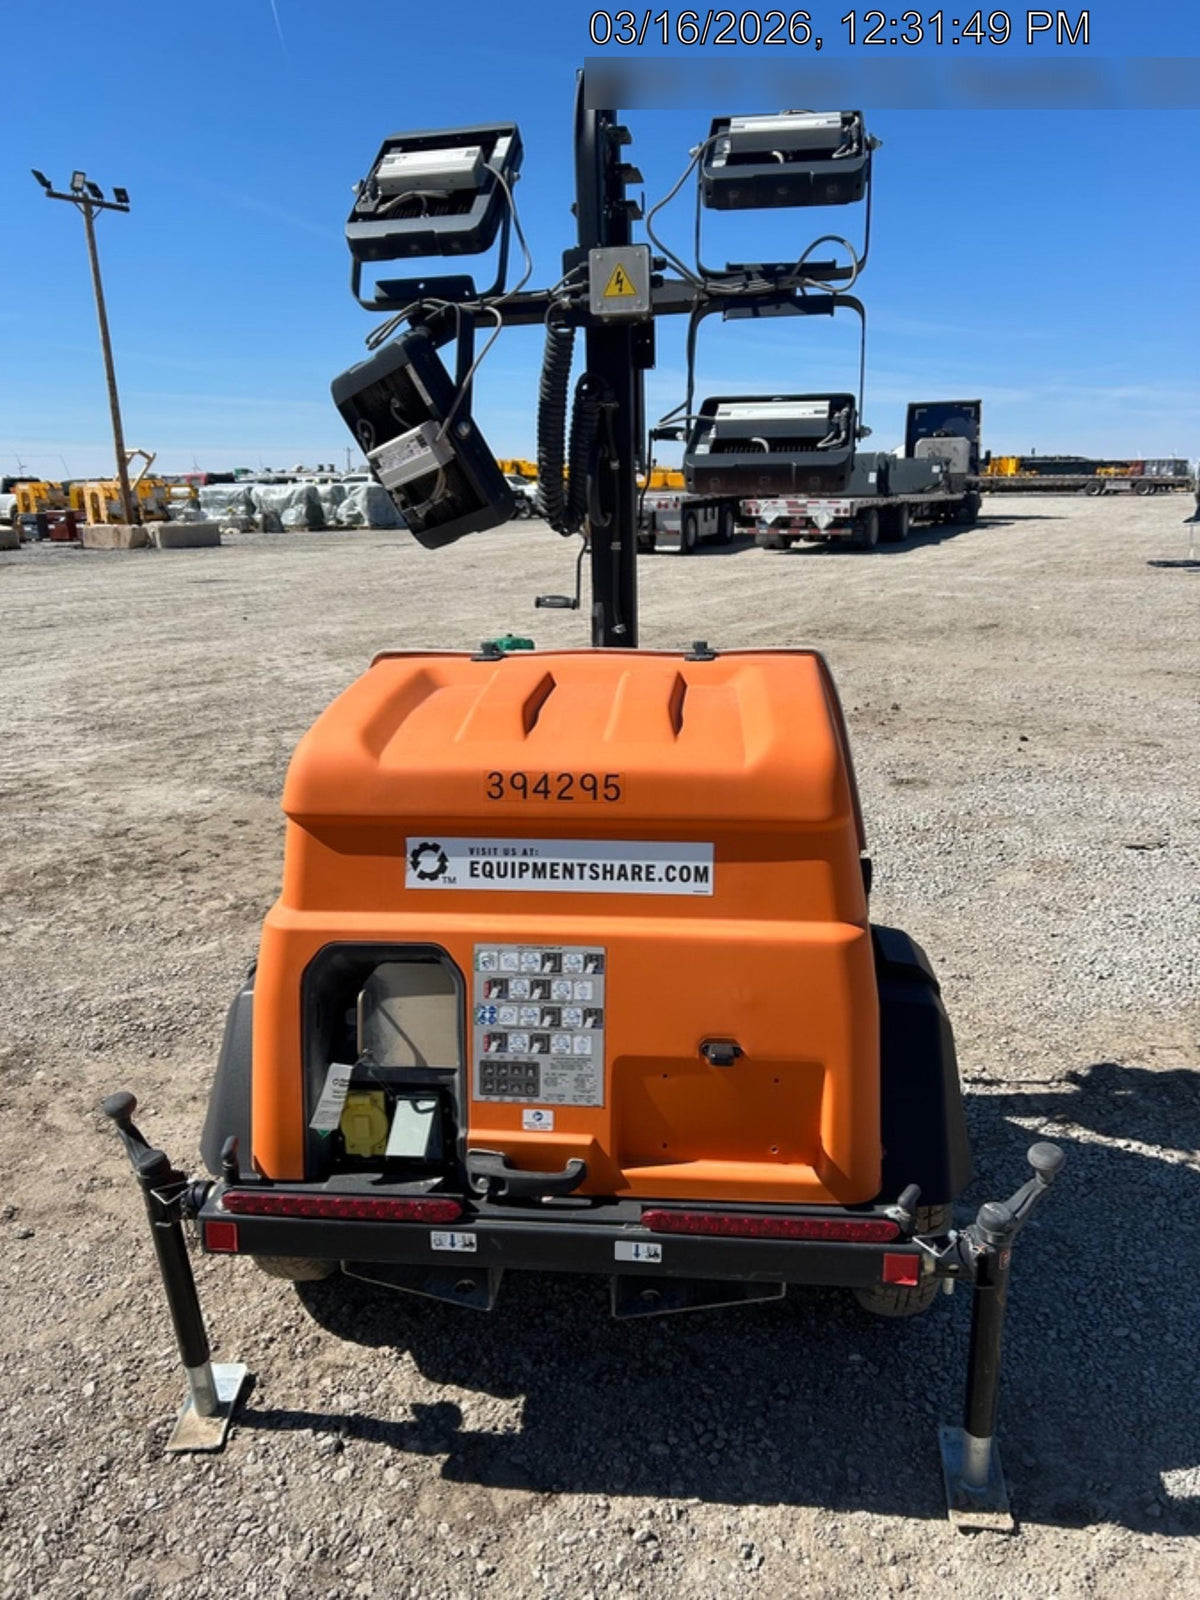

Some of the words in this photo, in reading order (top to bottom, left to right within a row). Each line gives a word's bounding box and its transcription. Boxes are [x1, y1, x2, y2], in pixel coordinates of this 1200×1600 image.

[486, 771, 622, 802] 394295
[469, 847, 498, 856] VISIT
[503, 848, 517, 856] US
[523, 848, 539, 857] AT:
[469, 860, 710, 884] EQUIPMENTSHARE.COM
